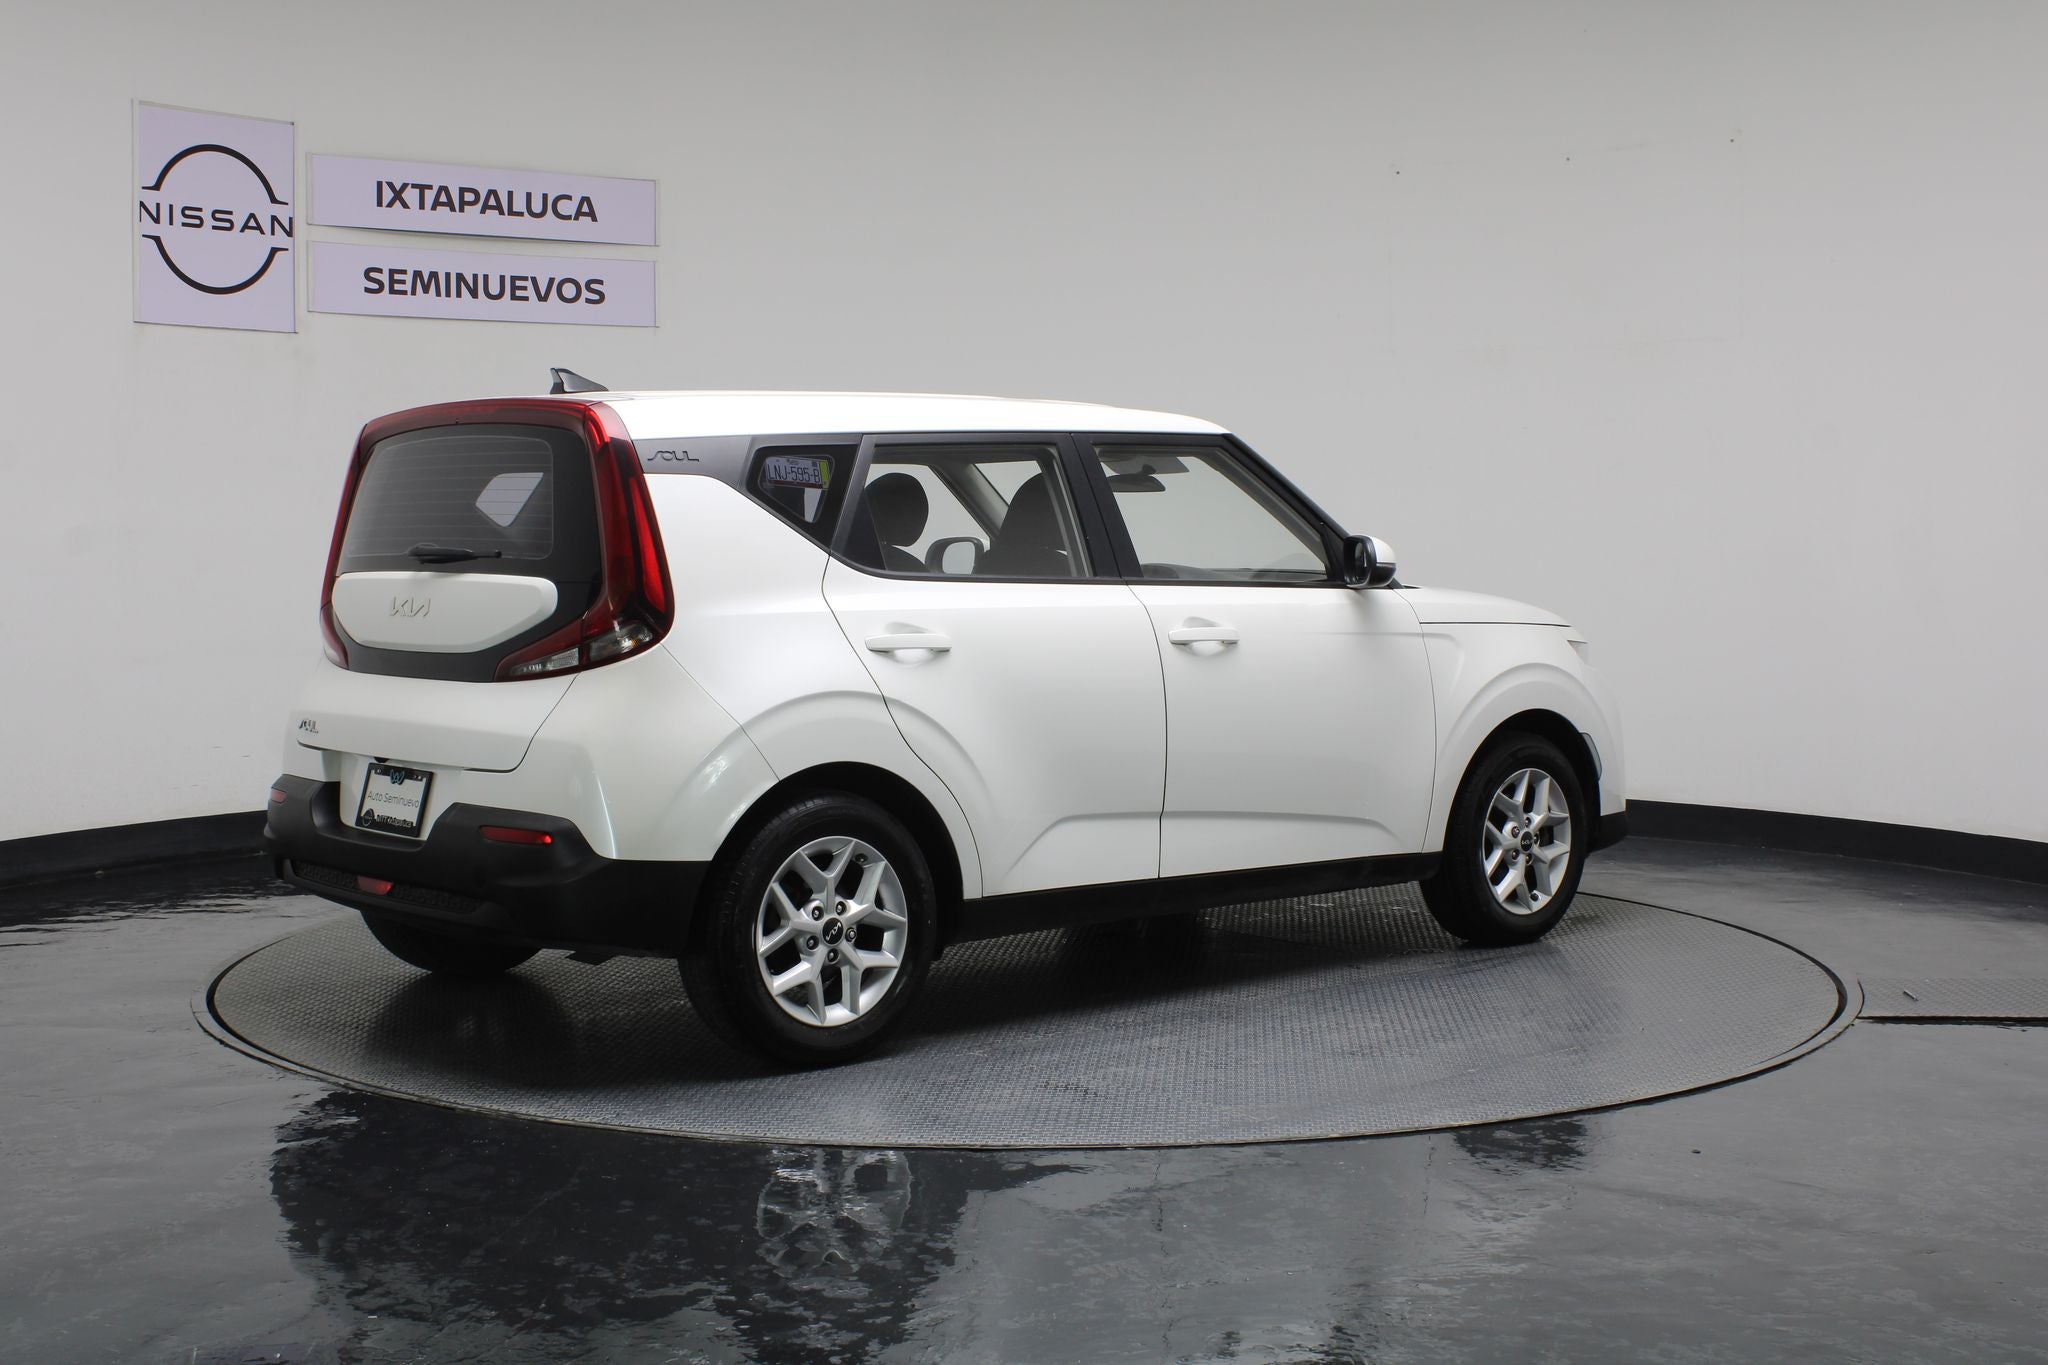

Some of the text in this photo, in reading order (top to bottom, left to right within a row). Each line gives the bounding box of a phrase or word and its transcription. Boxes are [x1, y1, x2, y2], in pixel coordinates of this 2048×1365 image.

[139, 200, 294, 238] NISSAN
[375, 180, 598, 223] IXTAPALUCA
[363, 266, 606, 305] SEMINUEVOS
[367, 790, 420, 808] Auto Seminuevo
